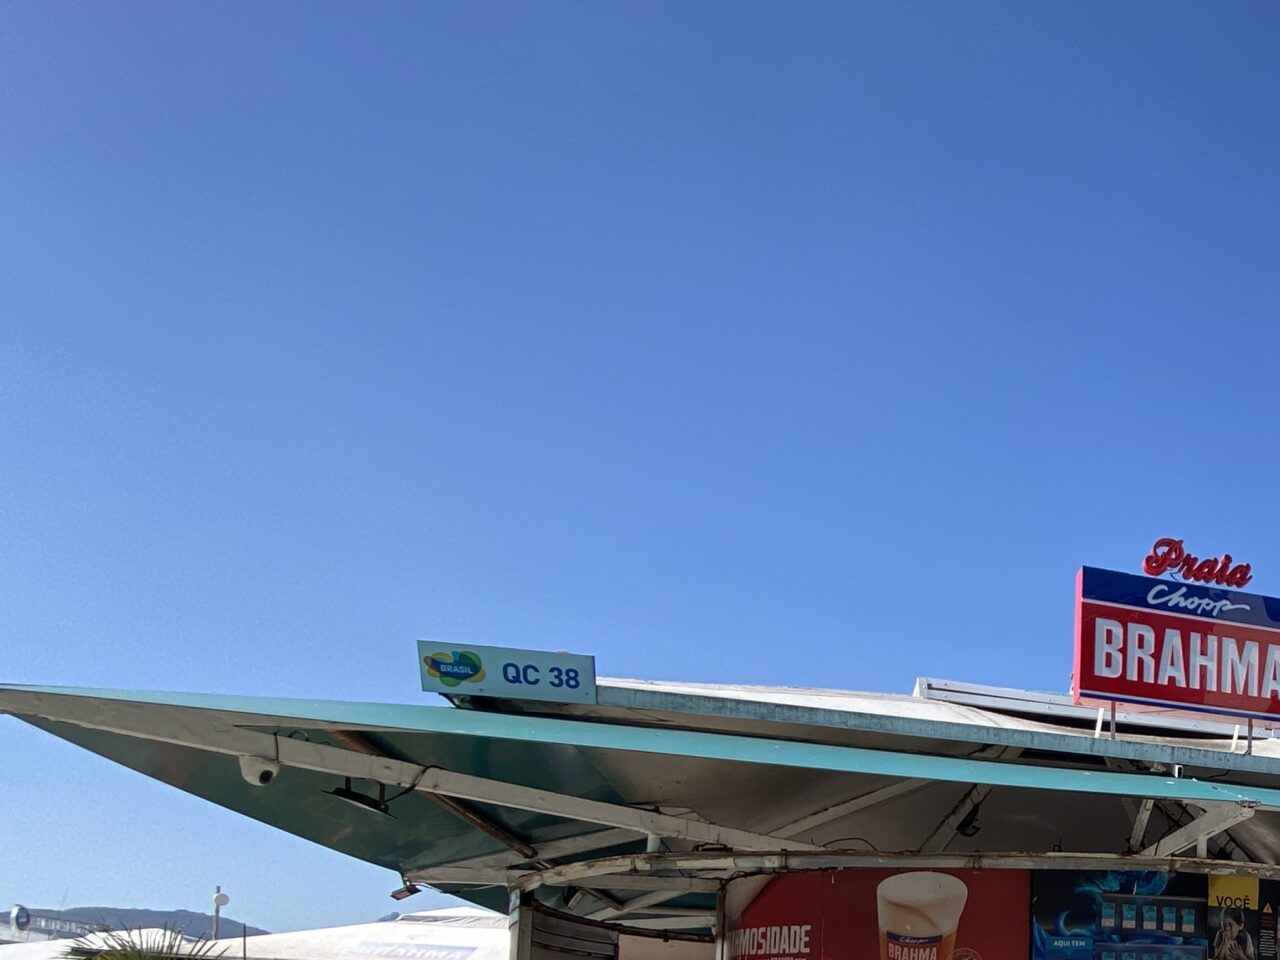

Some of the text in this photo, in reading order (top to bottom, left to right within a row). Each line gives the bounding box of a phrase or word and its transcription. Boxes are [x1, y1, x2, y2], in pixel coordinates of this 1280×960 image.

[1143, 537, 1253, 588] Praia
[1146, 584, 1250, 617] Chopp
[440, 663, 474, 675] BRASIL
[502, 662, 580, 689] QC 38
[1216, 895, 1251, 909] VOCÊ
